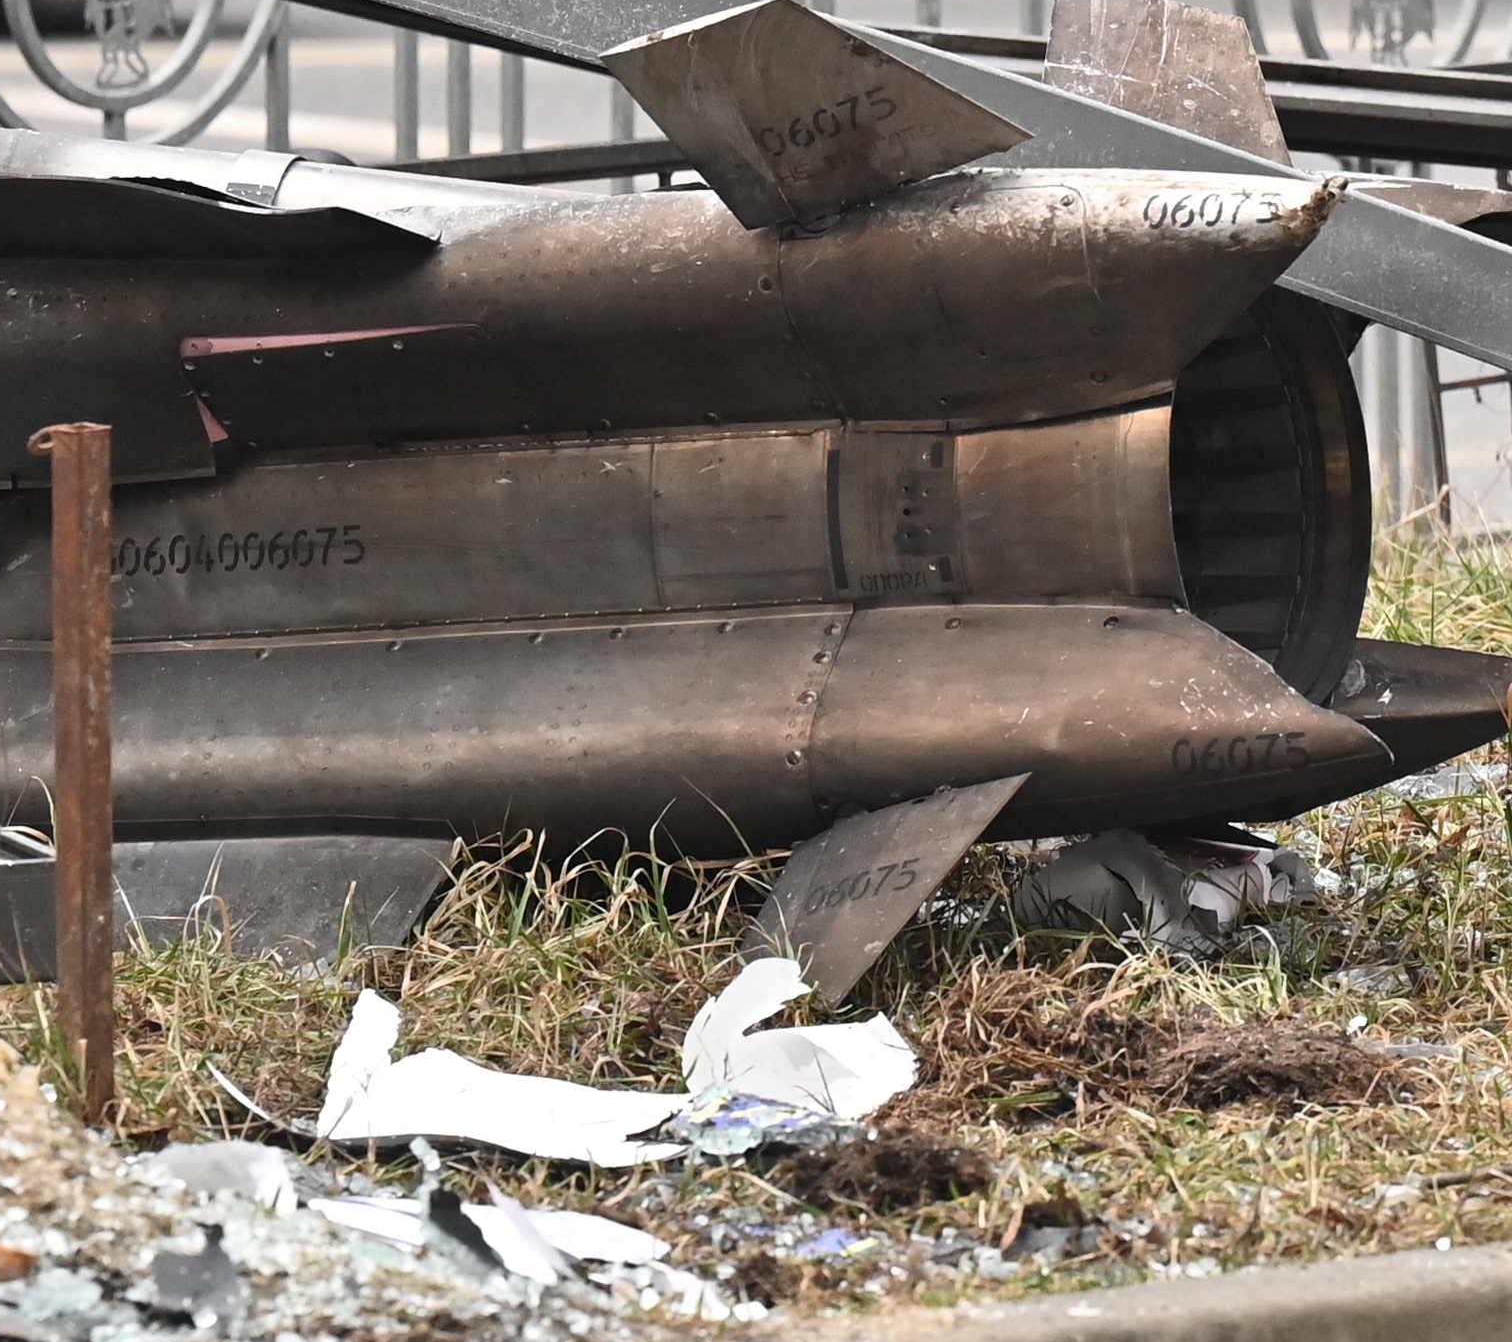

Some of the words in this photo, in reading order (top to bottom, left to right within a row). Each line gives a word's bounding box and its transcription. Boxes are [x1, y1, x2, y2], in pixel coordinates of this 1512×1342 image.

[758, 86, 897, 157] 06075
[111, 524, 366, 577] 0604006075
[1170, 731, 1312, 776] 06075
[804, 856, 921, 916] 06075
